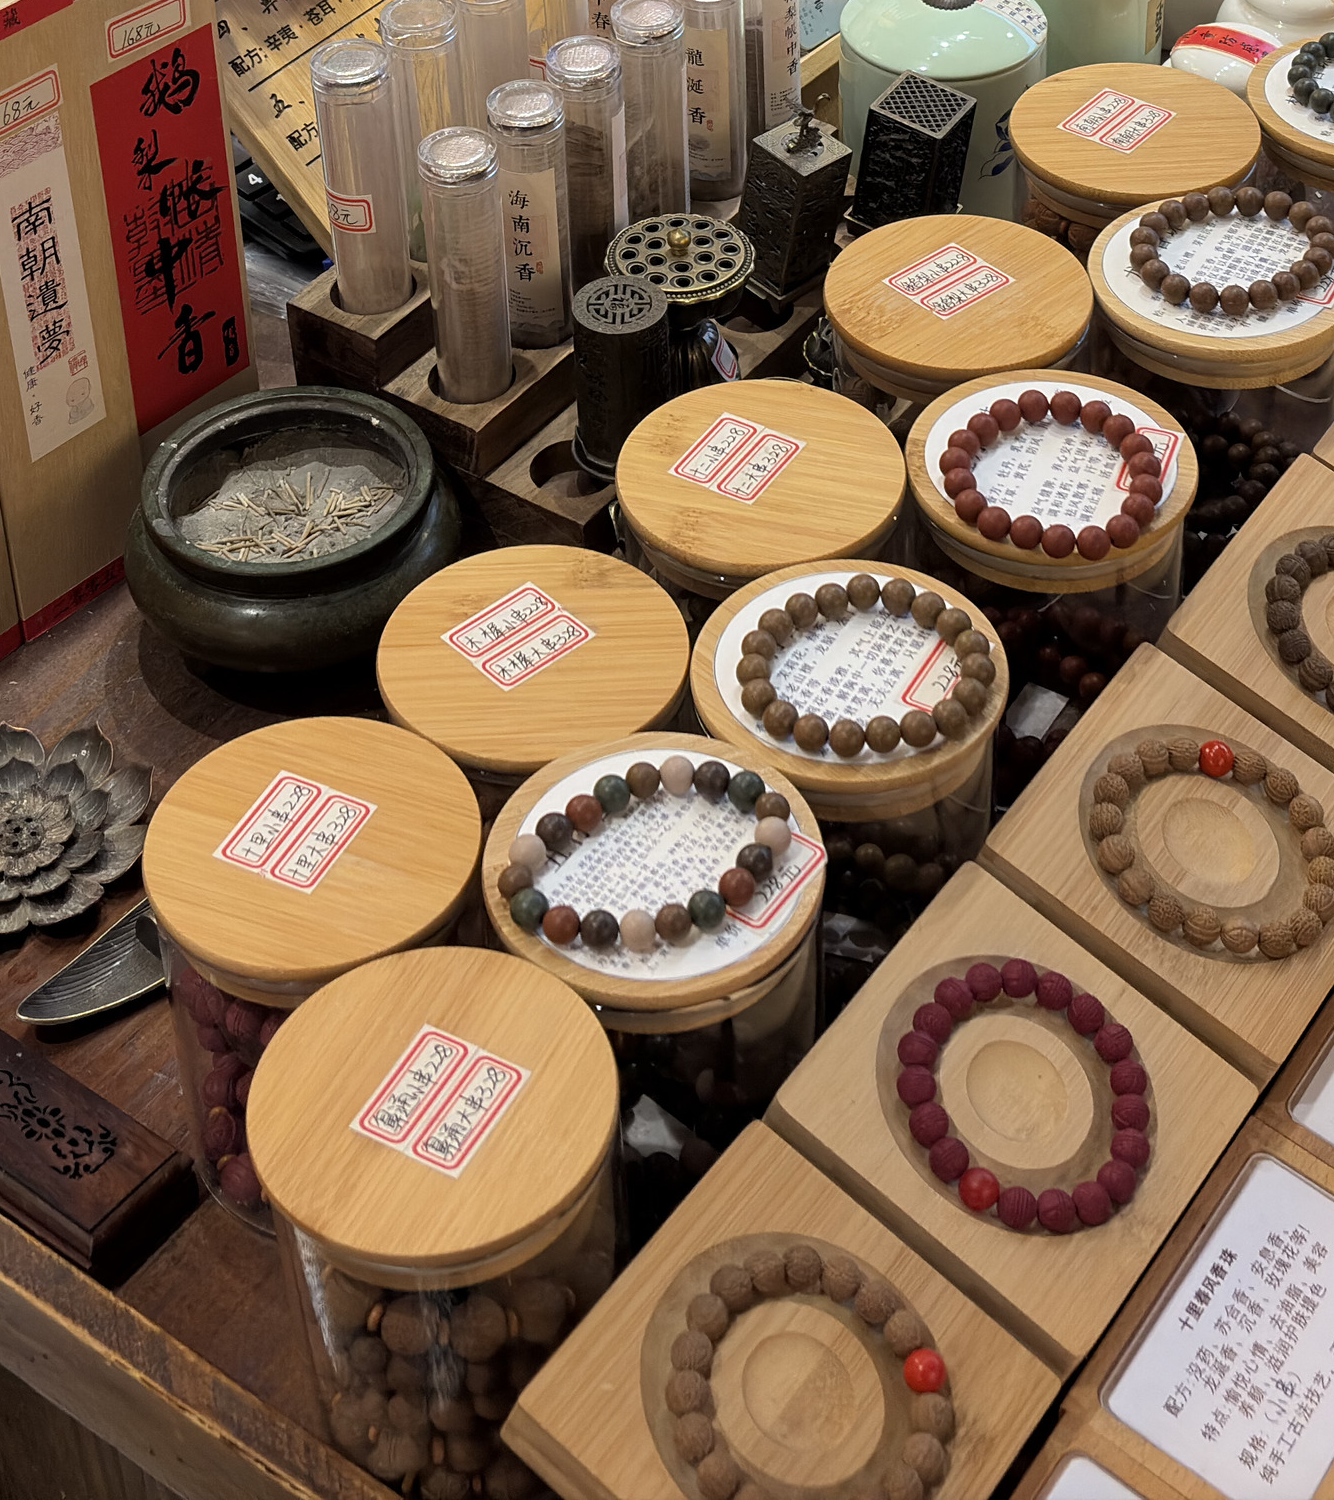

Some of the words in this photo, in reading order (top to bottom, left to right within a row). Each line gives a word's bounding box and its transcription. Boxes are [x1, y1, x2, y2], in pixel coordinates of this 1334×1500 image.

[117, 18, 164, 50] 168元
[508, 189, 537, 283] 海南沉香
[684, 424, 748, 479] 十二小串228
[725, 439, 791, 497] 十二大串328
[233, 781, 318, 863] 十里小串228
[279, 801, 363, 882] 十里大串328
[751, 853, 803, 911] 228元
[1172, 1245, 1241, 1334] 十里春风香珠
